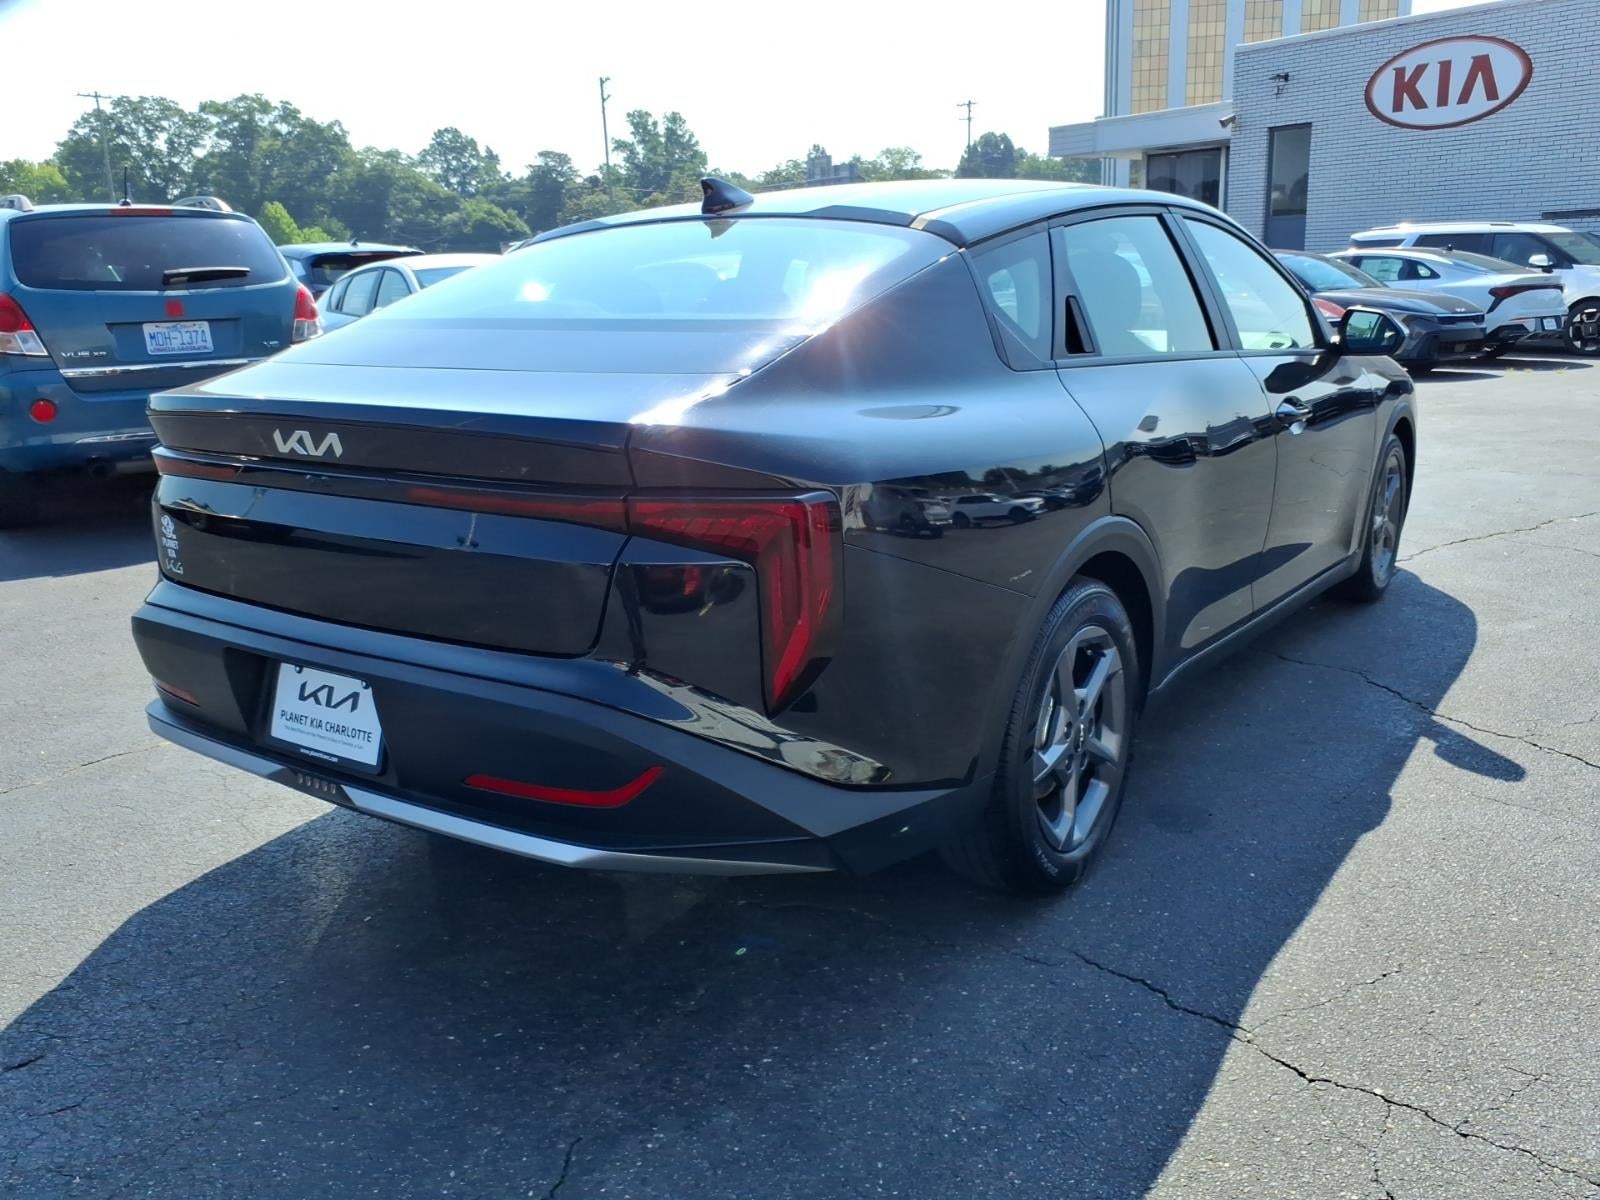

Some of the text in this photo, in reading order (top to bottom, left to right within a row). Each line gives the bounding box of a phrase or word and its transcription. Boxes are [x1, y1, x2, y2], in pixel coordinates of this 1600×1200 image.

[1392, 54, 1500, 113] KIA
[273, 428, 343, 458] KIA
[298, 681, 361, 713] KIA
[280, 709, 309, 727] PLANET
[310, 716, 323, 731] KIA
[325, 721, 373, 743] CHARLOTTE
